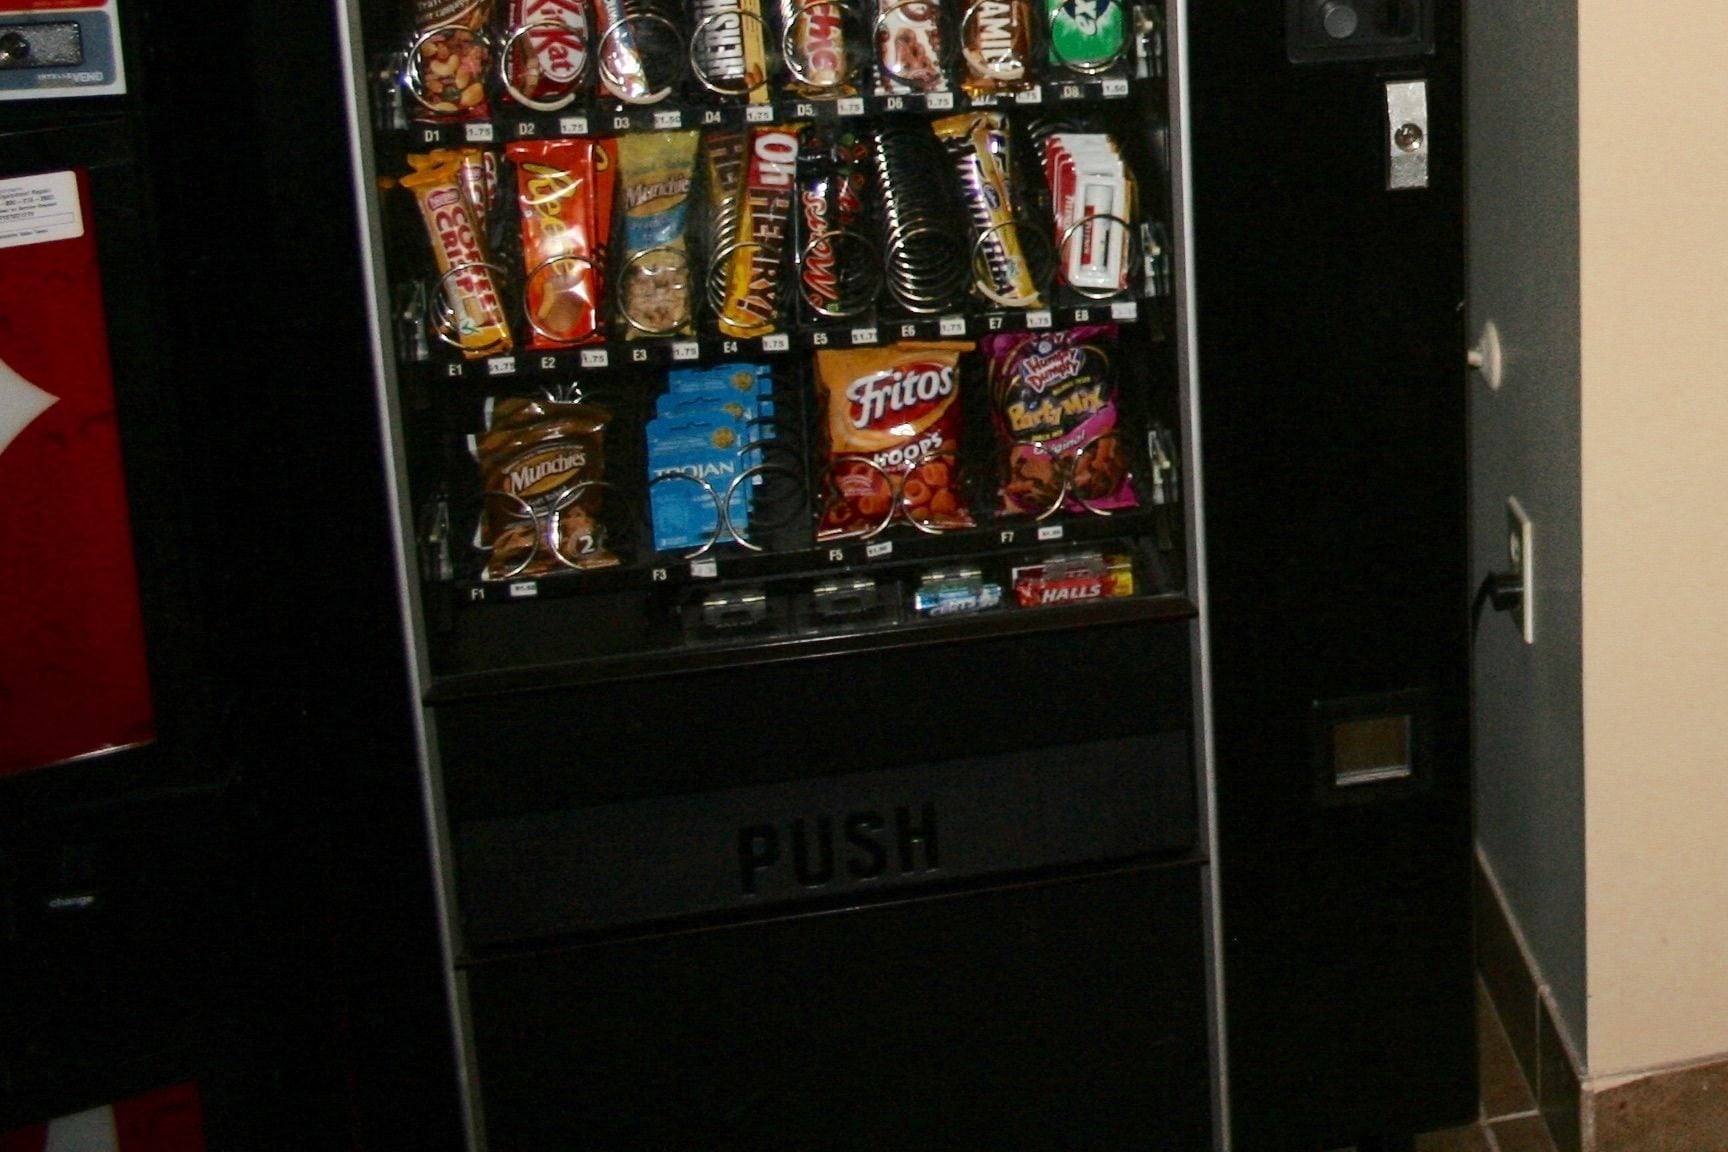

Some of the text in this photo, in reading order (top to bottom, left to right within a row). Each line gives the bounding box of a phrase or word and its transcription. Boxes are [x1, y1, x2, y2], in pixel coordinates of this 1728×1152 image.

[527, 28, 585, 72] Kat
[1063, 85, 1080, 98] D8
[797, 103, 814, 116] D5
[838, 103, 861, 113] 1.75
[887, 97, 903, 110] D6
[614, 116, 630, 129] D3
[705, 110, 721, 123] D4
[424, 129, 440, 142] D1
[519, 123, 535, 136] D2
[436, 211, 474, 293] CRISP
[452, 206, 498, 310] COFFEE
[941, 322, 963, 332] 1.75
[989, 318, 1003, 330] E7
[901, 325, 915, 337] E6
[813, 333, 828, 345] E5
[724, 341, 737, 353] E4
[633, 349, 647, 361] E3
[1023, 348, 1080, 375] Humpty
[541, 357, 556, 369] E2
[448, 364, 462, 377] E1
[846, 366, 953, 429] Fritos
[509, 451, 586, 494] Munchies
[654, 459, 734, 478] TROJAN
[1000, 531, 1014, 543] F7
[829, 549, 844, 561] F5
[652, 569, 667, 581] F3
[471, 588, 485, 599] F1
[1041, 583, 1101, 604] HALLS
[738, 801, 941, 897] PUSH
[48, 895, 95, 909] change
